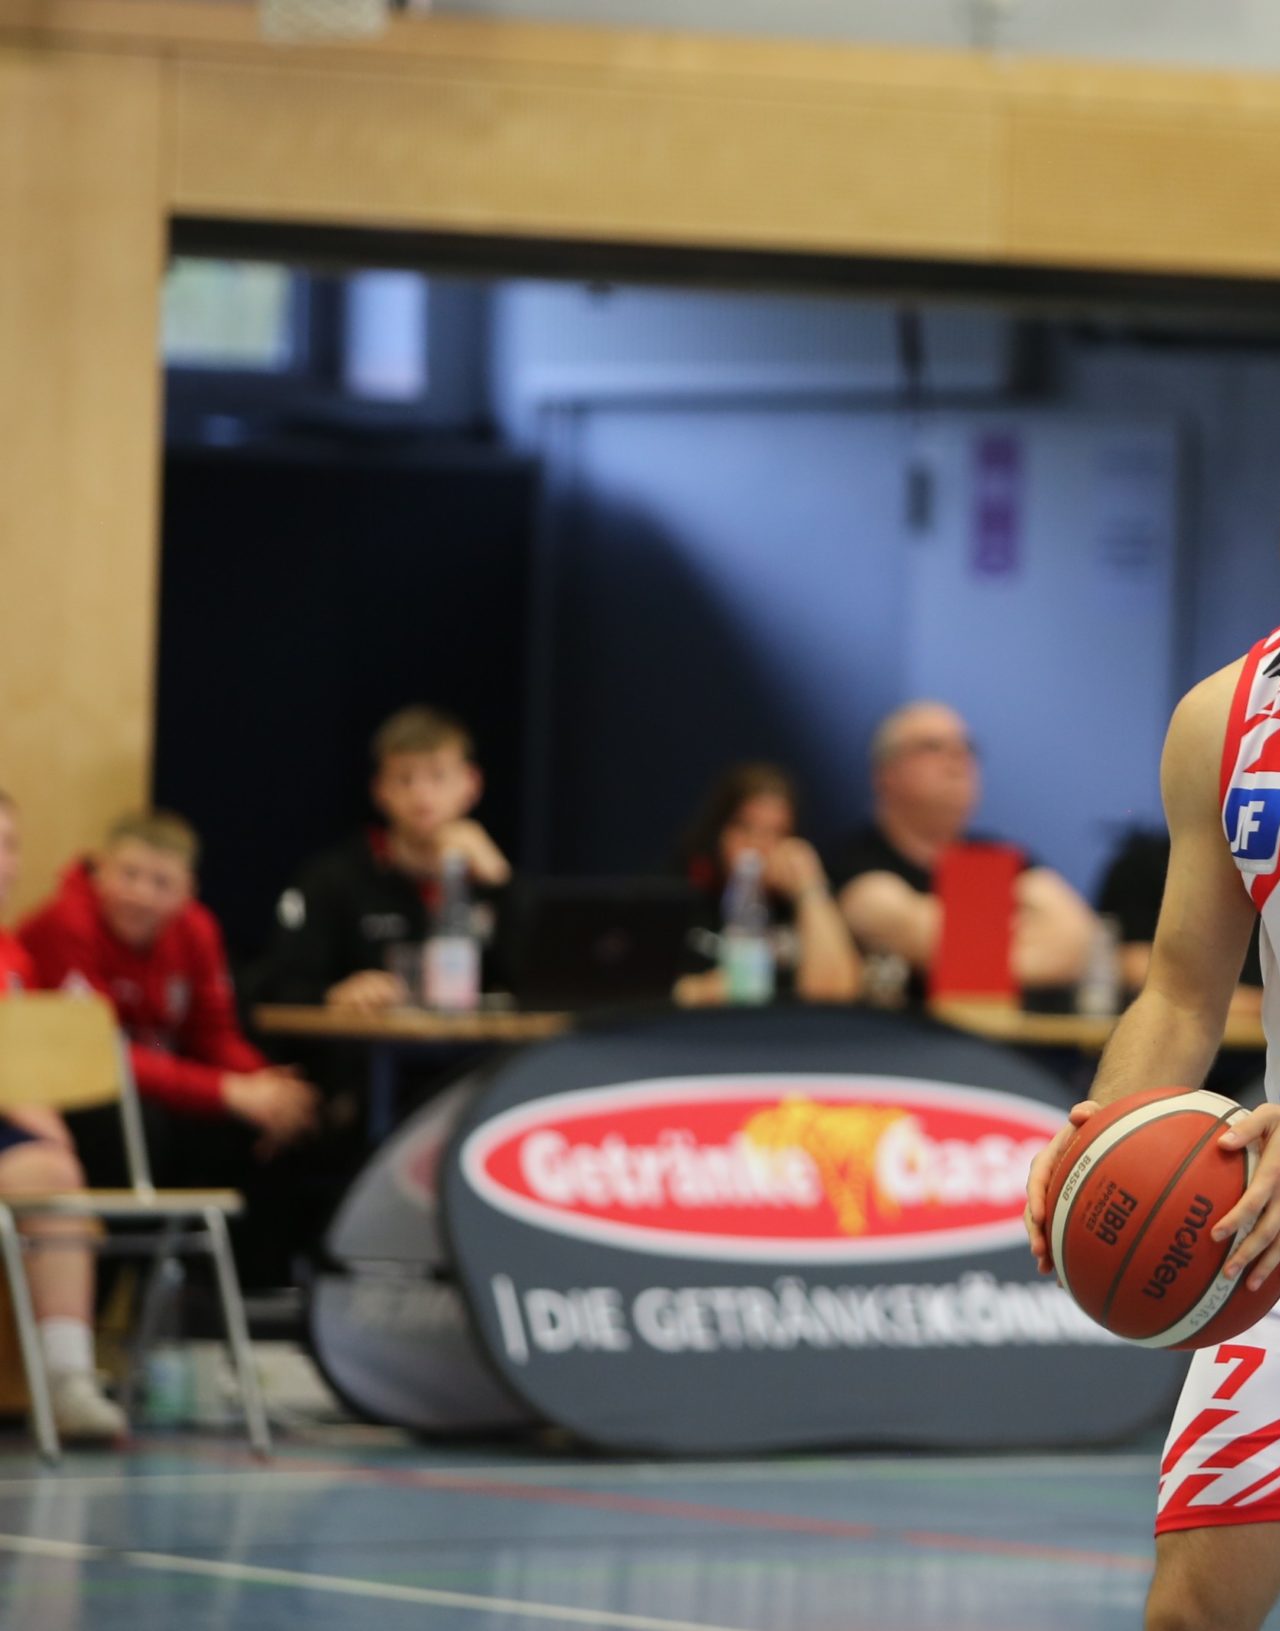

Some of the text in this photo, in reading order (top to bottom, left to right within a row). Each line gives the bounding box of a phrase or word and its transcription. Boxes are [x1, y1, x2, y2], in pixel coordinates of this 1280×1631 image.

[519, 1127, 822, 1208] Getränke
[1096, 1187, 1138, 1246] FIBA
[1142, 1194, 1214, 1299] molten
[525, 1286, 631, 1352] DIE
[1212, 1344, 1267, 1400] 7
